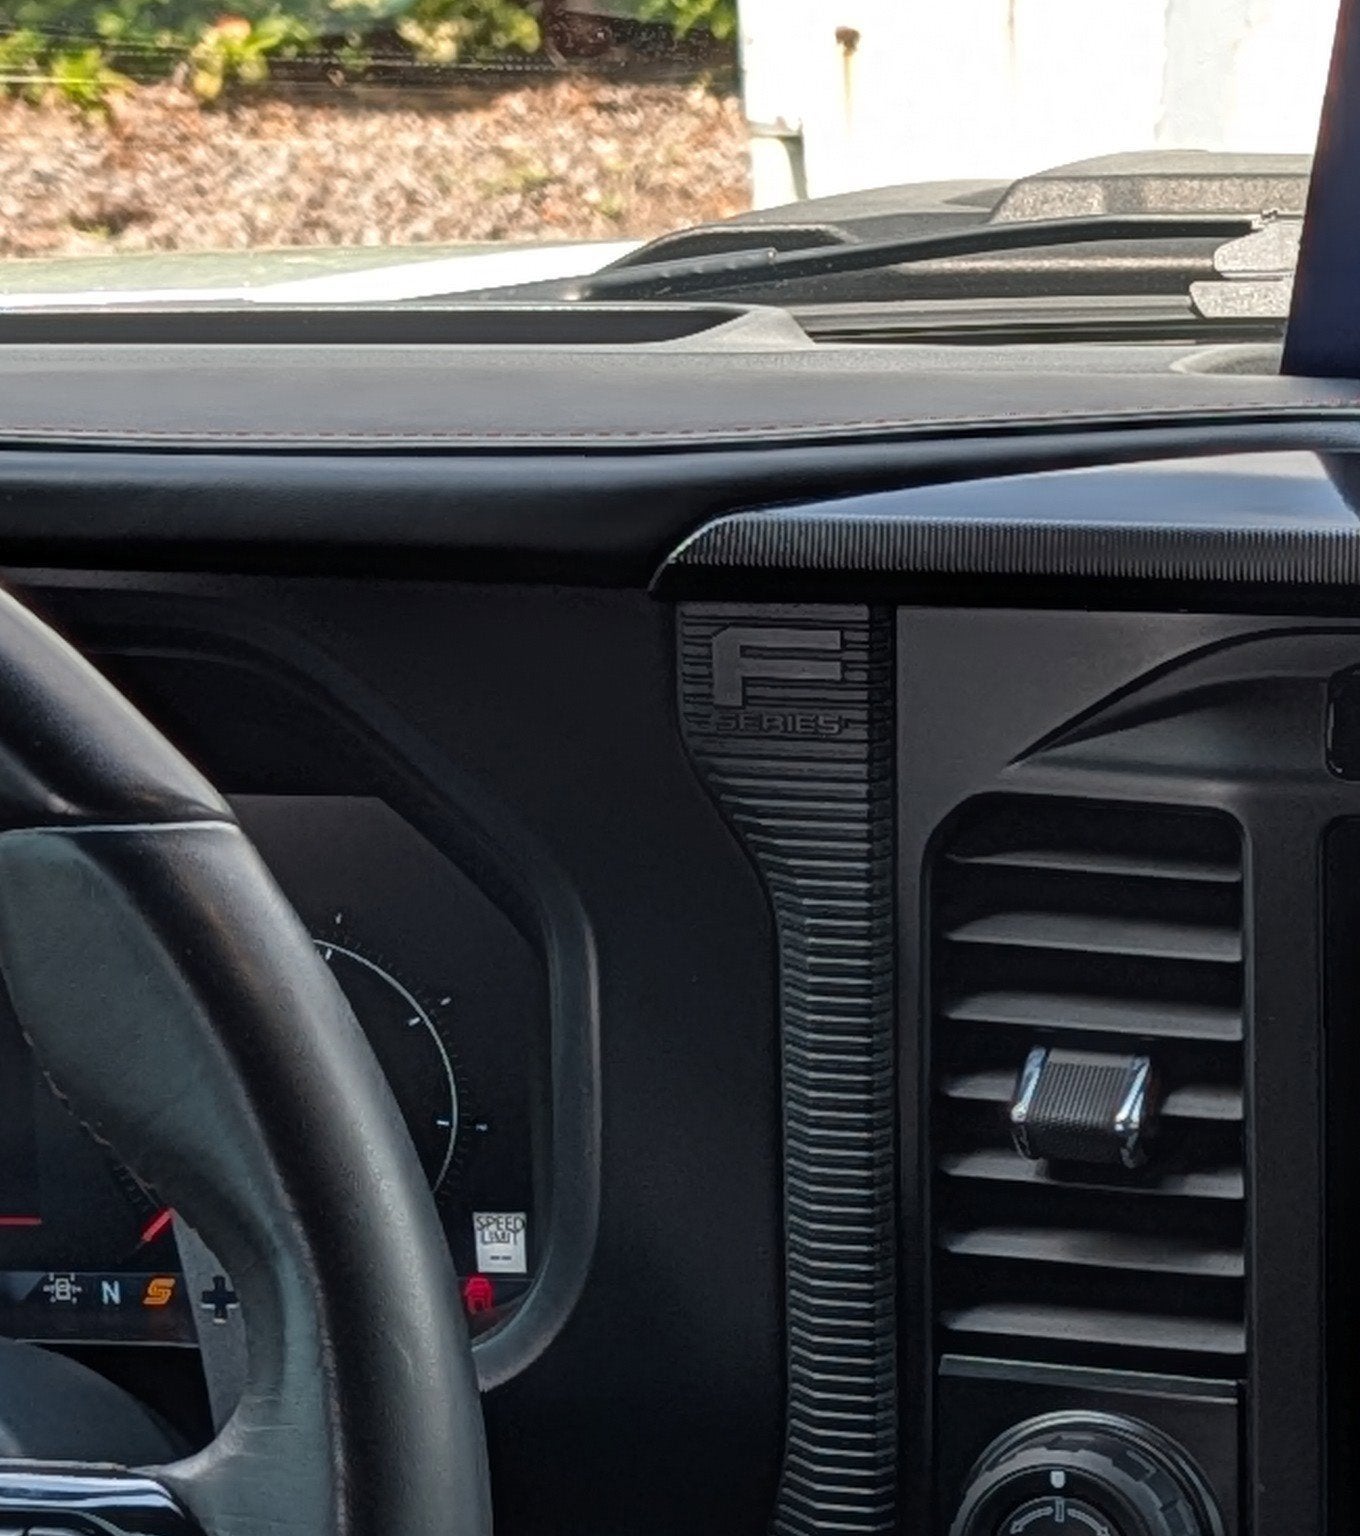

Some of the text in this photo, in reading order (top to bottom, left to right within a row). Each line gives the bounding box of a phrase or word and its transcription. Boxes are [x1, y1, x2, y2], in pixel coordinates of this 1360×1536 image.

[716, 712, 844, 736] SERIES
[476, 1215, 526, 1234] SPEED
[101, 1280, 121, 1306] N
